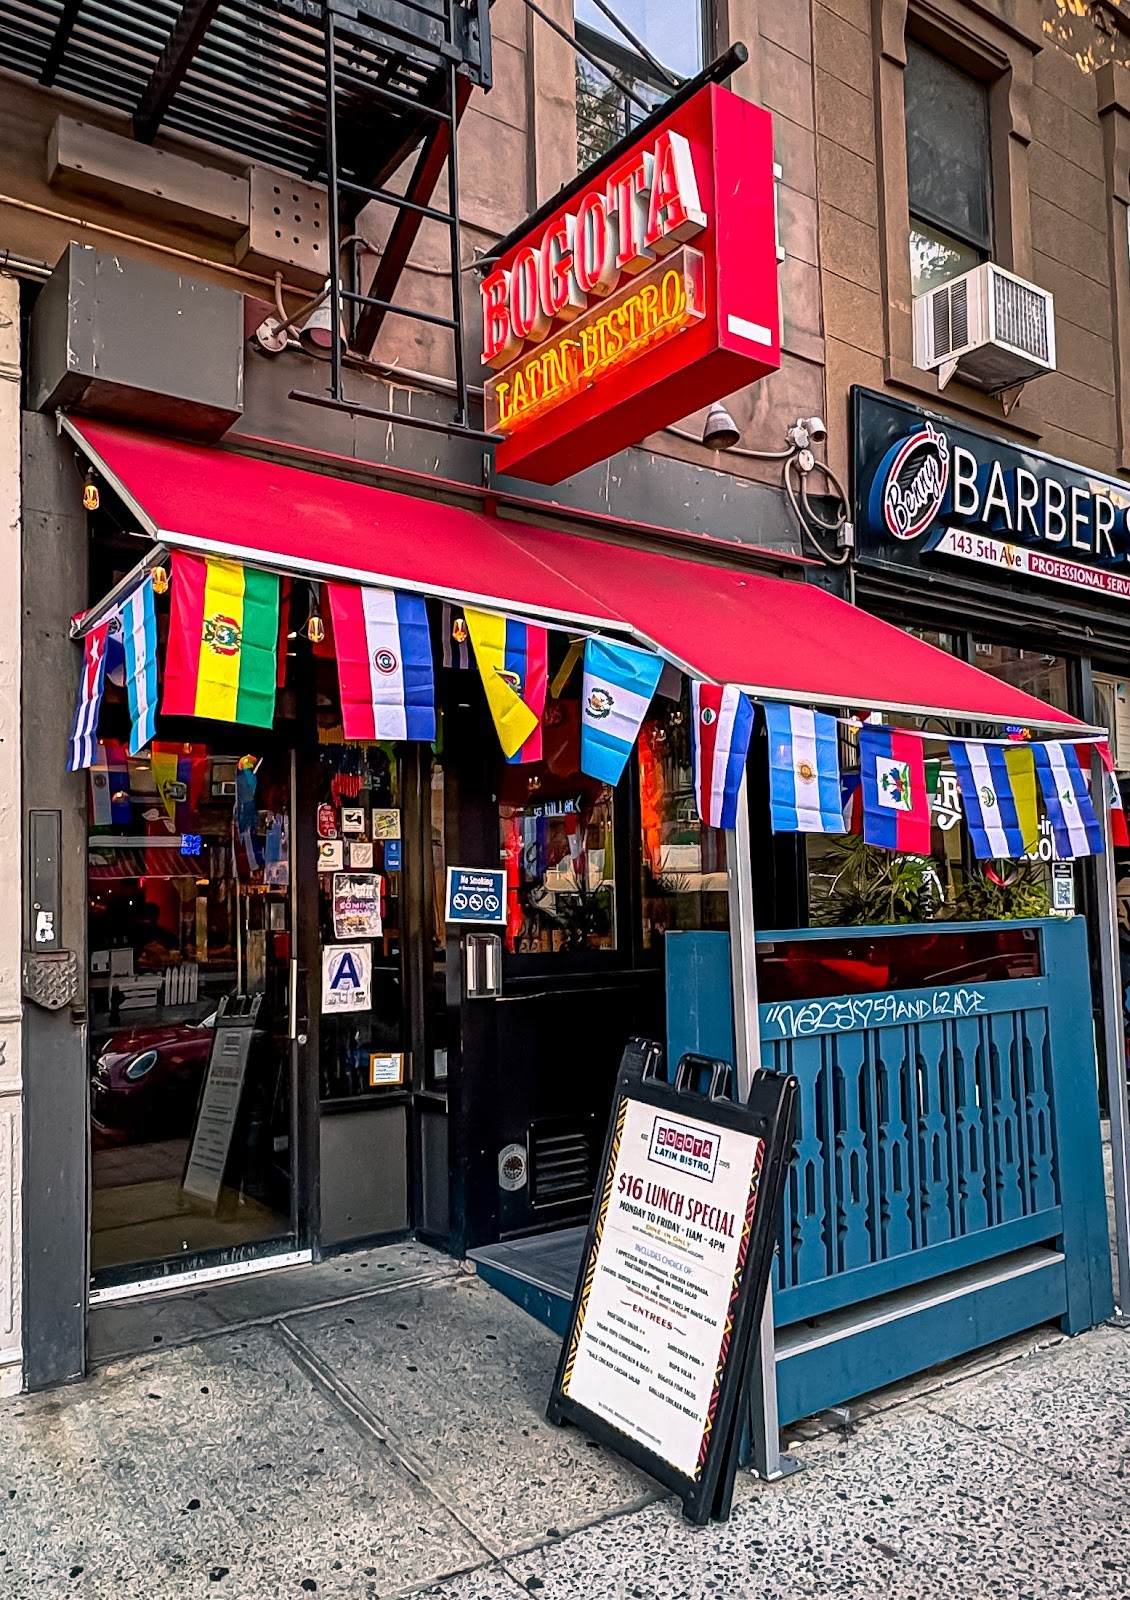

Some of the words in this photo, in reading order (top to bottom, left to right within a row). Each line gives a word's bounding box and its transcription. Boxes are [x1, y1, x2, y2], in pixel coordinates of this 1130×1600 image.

[481, 129, 706, 367] BOGOTA
[494, 341, 578, 427] LATIN
[578, 270, 687, 377] BISTRO
[949, 533, 973, 555] 143
[976, 541, 997, 561] 5th
[1000, 546, 1022, 568] Ave
[1031, 556, 1105, 588] PROFESSIONAL
[460, 875, 468, 884] No
[470, 876, 494, 887] Smoking
[330, 952, 361, 989] A
[654, 1145, 678, 1161] LATIN
[656, 1126, 713, 1160] BOGOTA
[617, 1172, 644, 1200] $16
[644, 1182, 685, 1217] LUNCH
[684, 1197, 735, 1239] SPECIAL
[618, 1200, 647, 1219] MONDAY
[647, 1211, 656, 1223] TO
[656, 1215, 680, 1234] FRIDAY
[685, 1227, 703, 1243] 11AM
[708, 1237, 725, 1253] 4PM
[634, 1243, 661, 1262] INCLUDES
[661, 1255, 683, 1272] CHOICE
[632, 1303, 673, 1330] ENTREES
